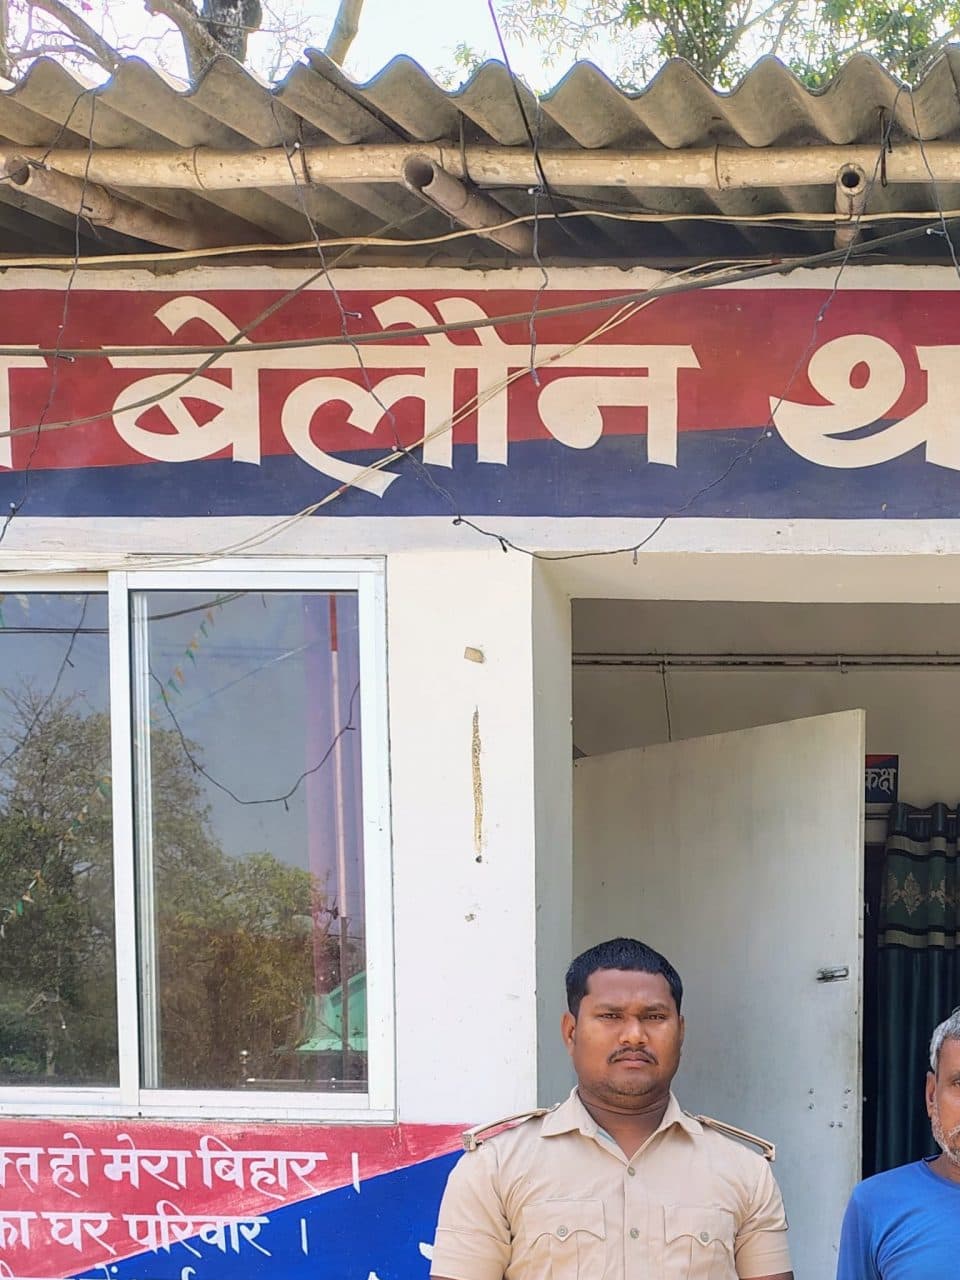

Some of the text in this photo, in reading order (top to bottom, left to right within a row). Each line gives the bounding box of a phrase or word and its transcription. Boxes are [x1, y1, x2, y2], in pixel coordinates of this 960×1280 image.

[48, 1133, 95, 1198] हो
[101, 1133, 192, 1190] मेरा
[195, 1135, 327, 1201] बिहार
[41, 1212, 117, 1256] घर
[122, 1200, 272, 1258] परिवार
